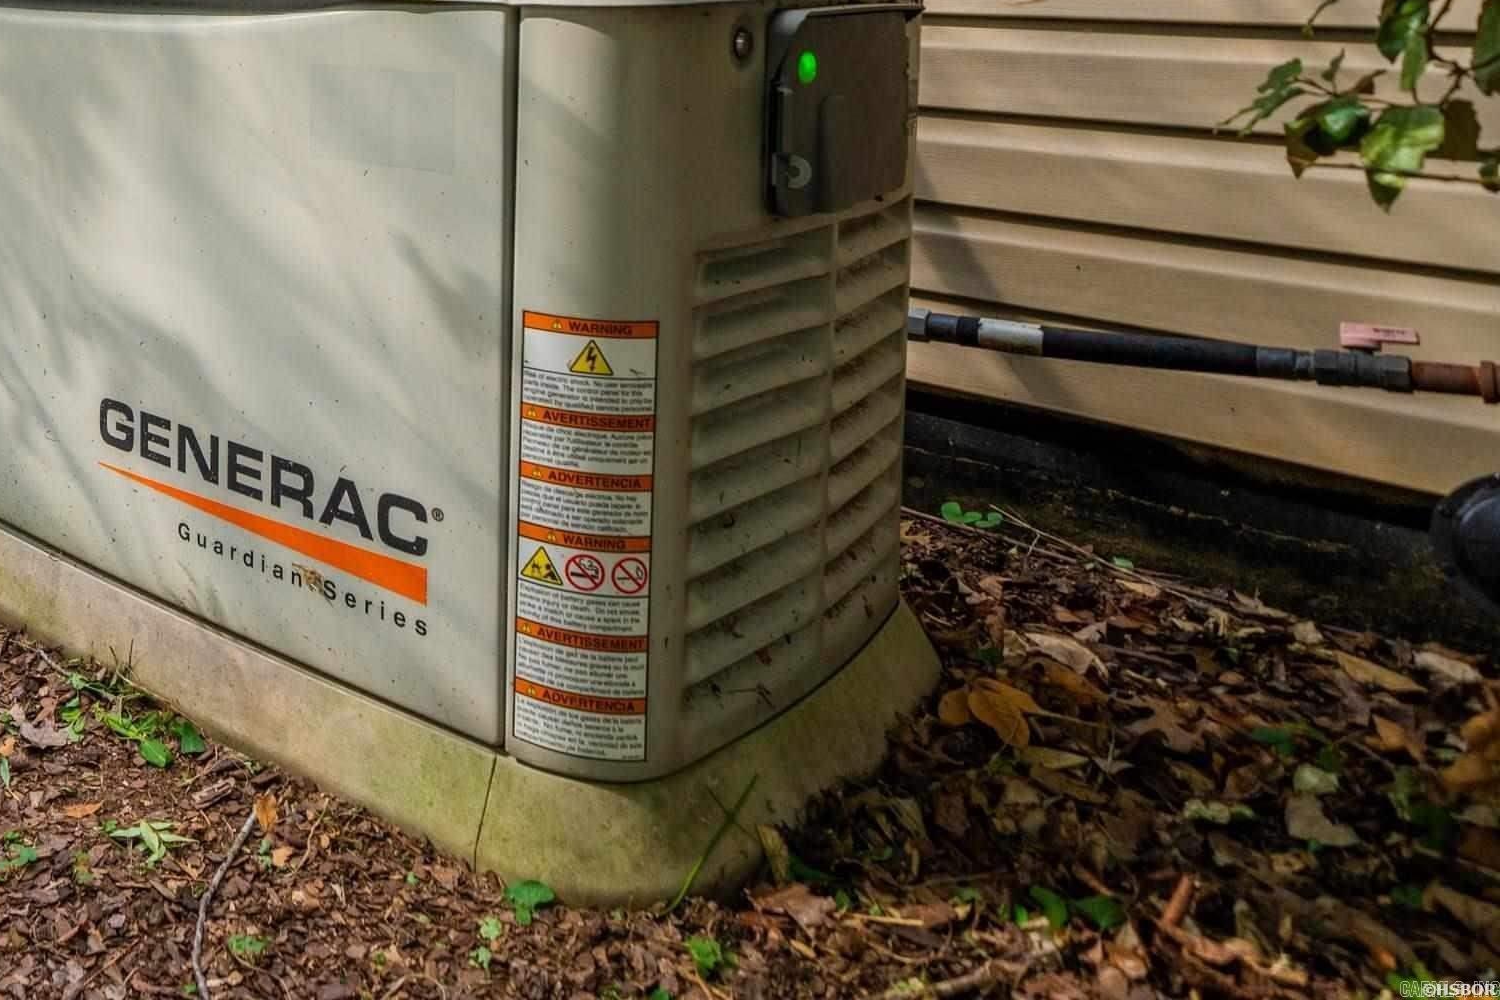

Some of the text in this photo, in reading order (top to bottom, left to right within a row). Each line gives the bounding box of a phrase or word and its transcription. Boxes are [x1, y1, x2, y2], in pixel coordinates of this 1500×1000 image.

[568, 320, 633, 337] WARNING
[543, 410, 651, 430] AVERTISSEMENT
[548, 470, 642, 489] ADVERTENCIA
[563, 533, 627, 551] WARNING
[178, 522, 429, 636] Guardian Series
[537, 627, 645, 650] AVERTISSEMENT
[543, 690, 636, 713] ADVERTENCIA
